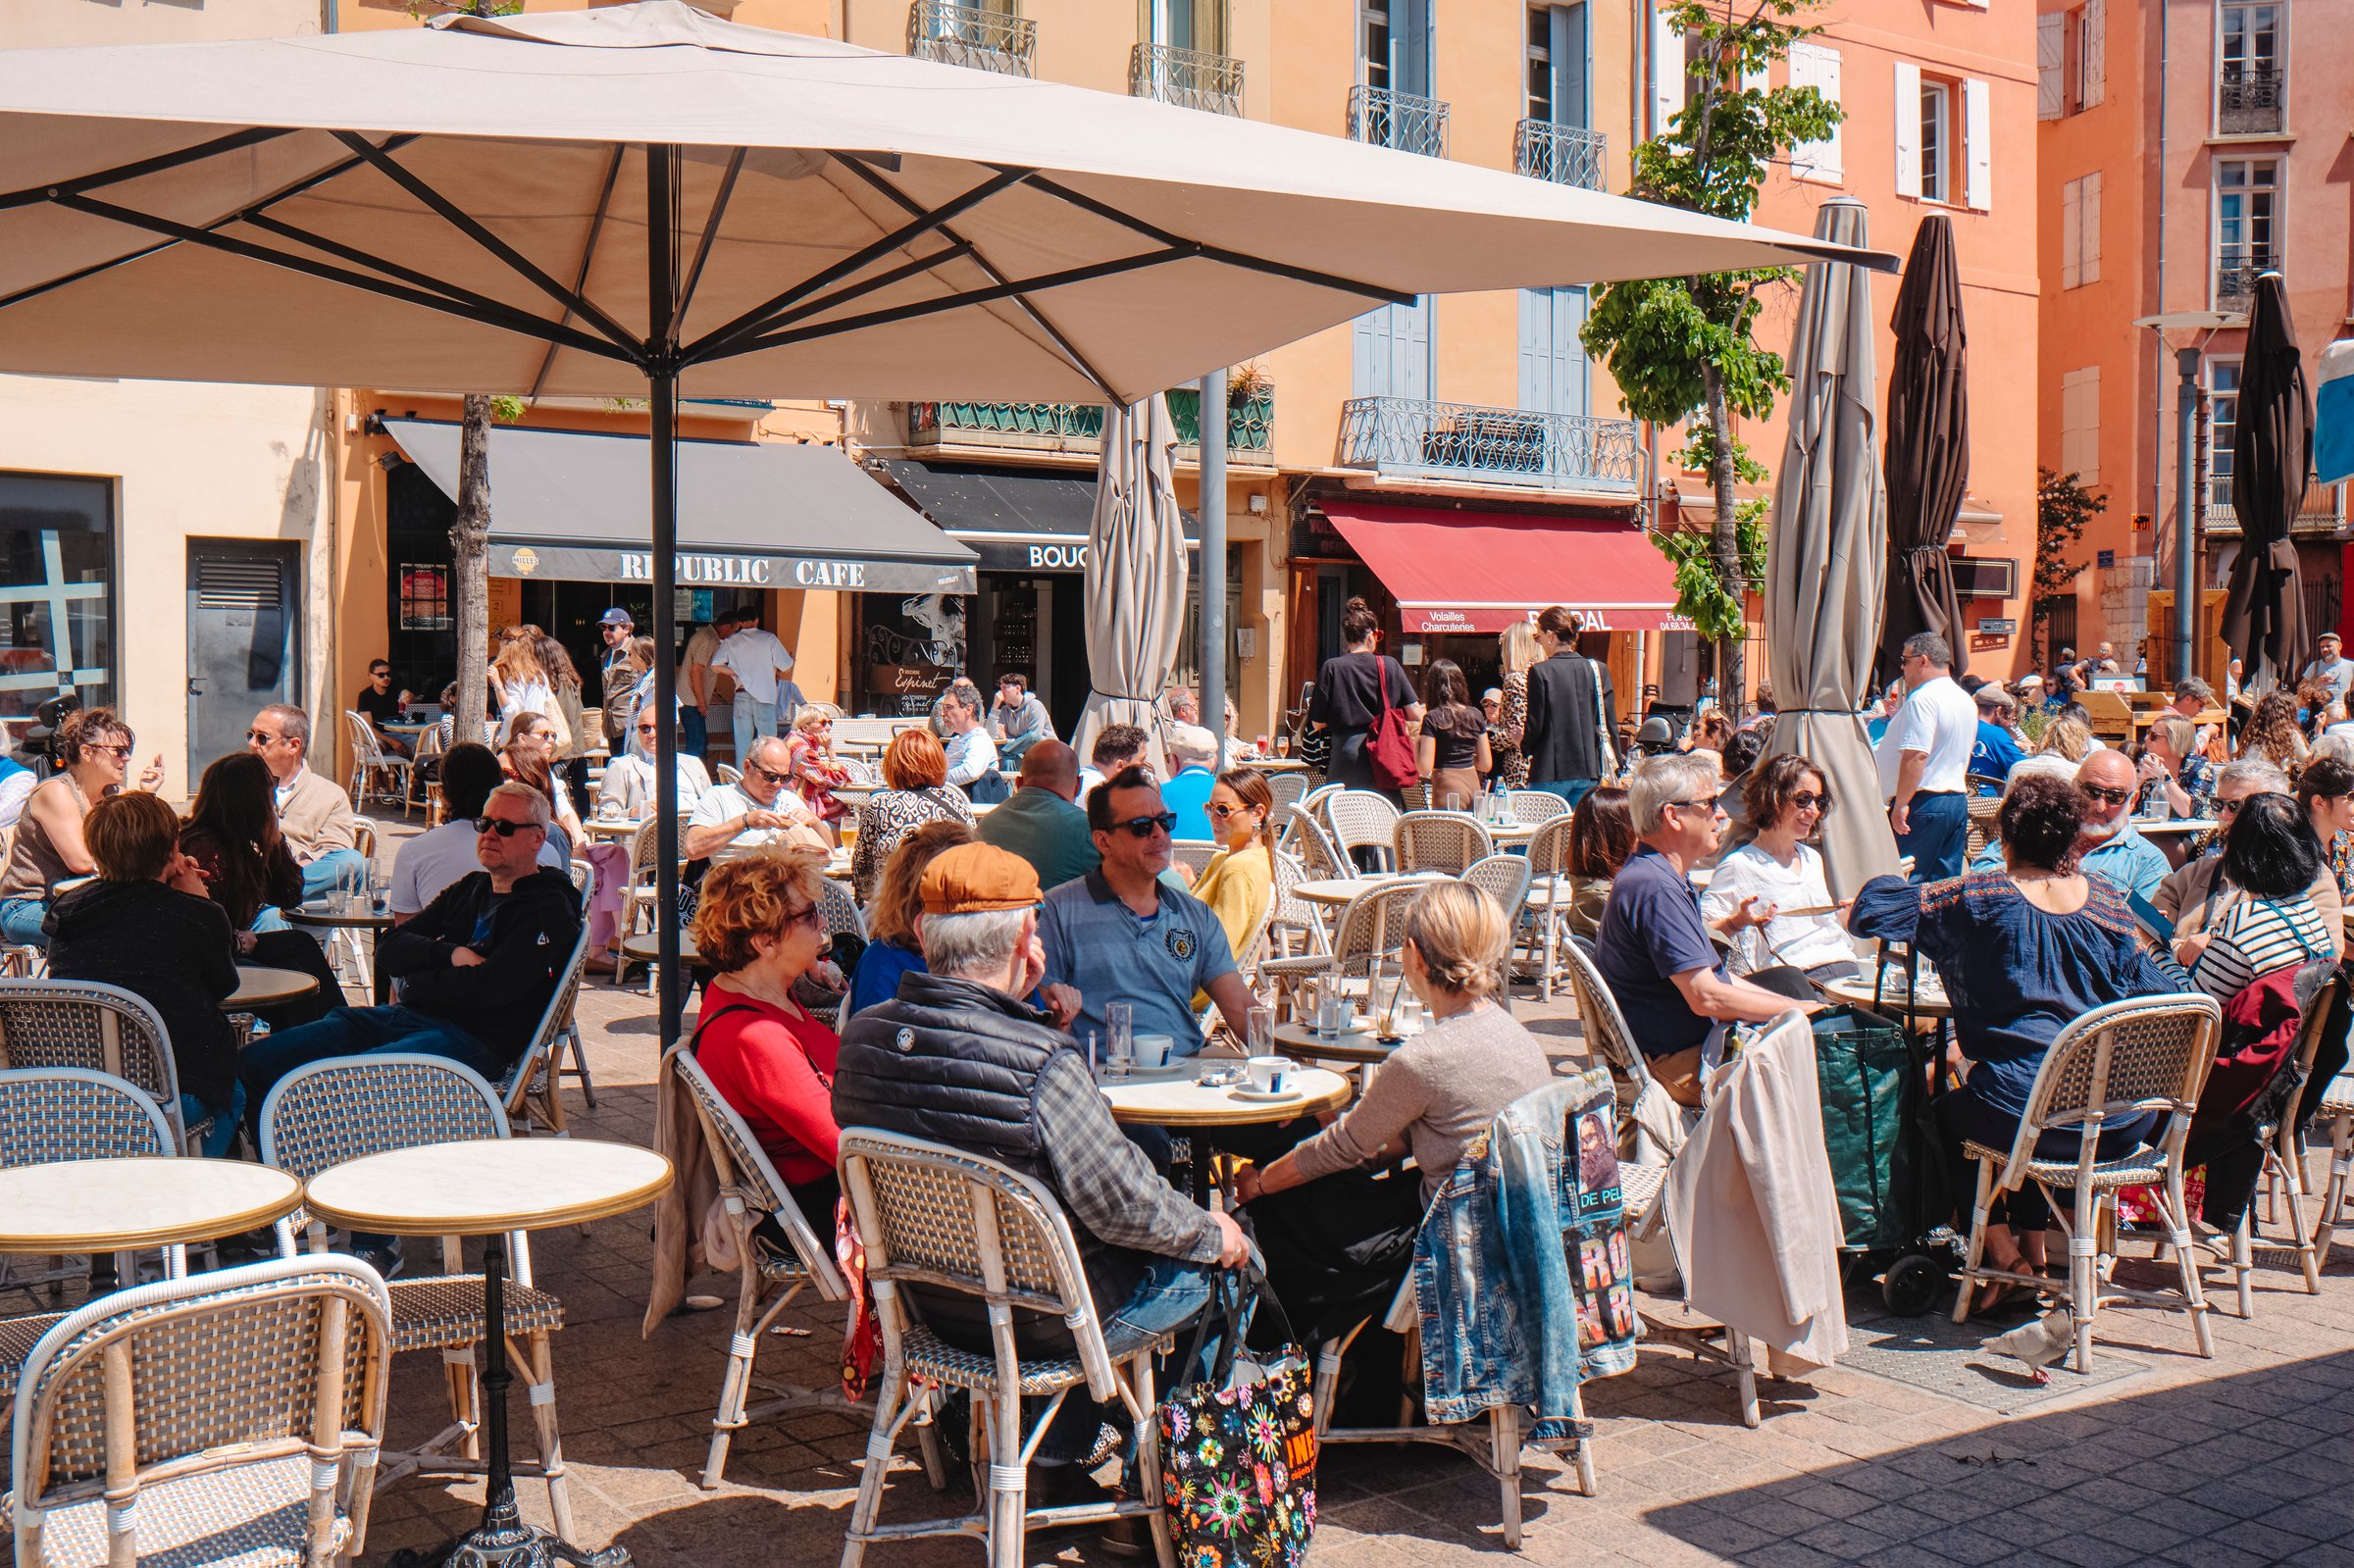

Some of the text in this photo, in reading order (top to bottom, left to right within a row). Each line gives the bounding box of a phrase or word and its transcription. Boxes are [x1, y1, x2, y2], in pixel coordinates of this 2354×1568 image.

[621, 553, 865, 587] RUBLIC CAFE
[1429, 612, 1465, 622] Volailles
[1422, 622, 1475, 632] Charcuteries
[1580, 1191, 1599, 1208] DE
